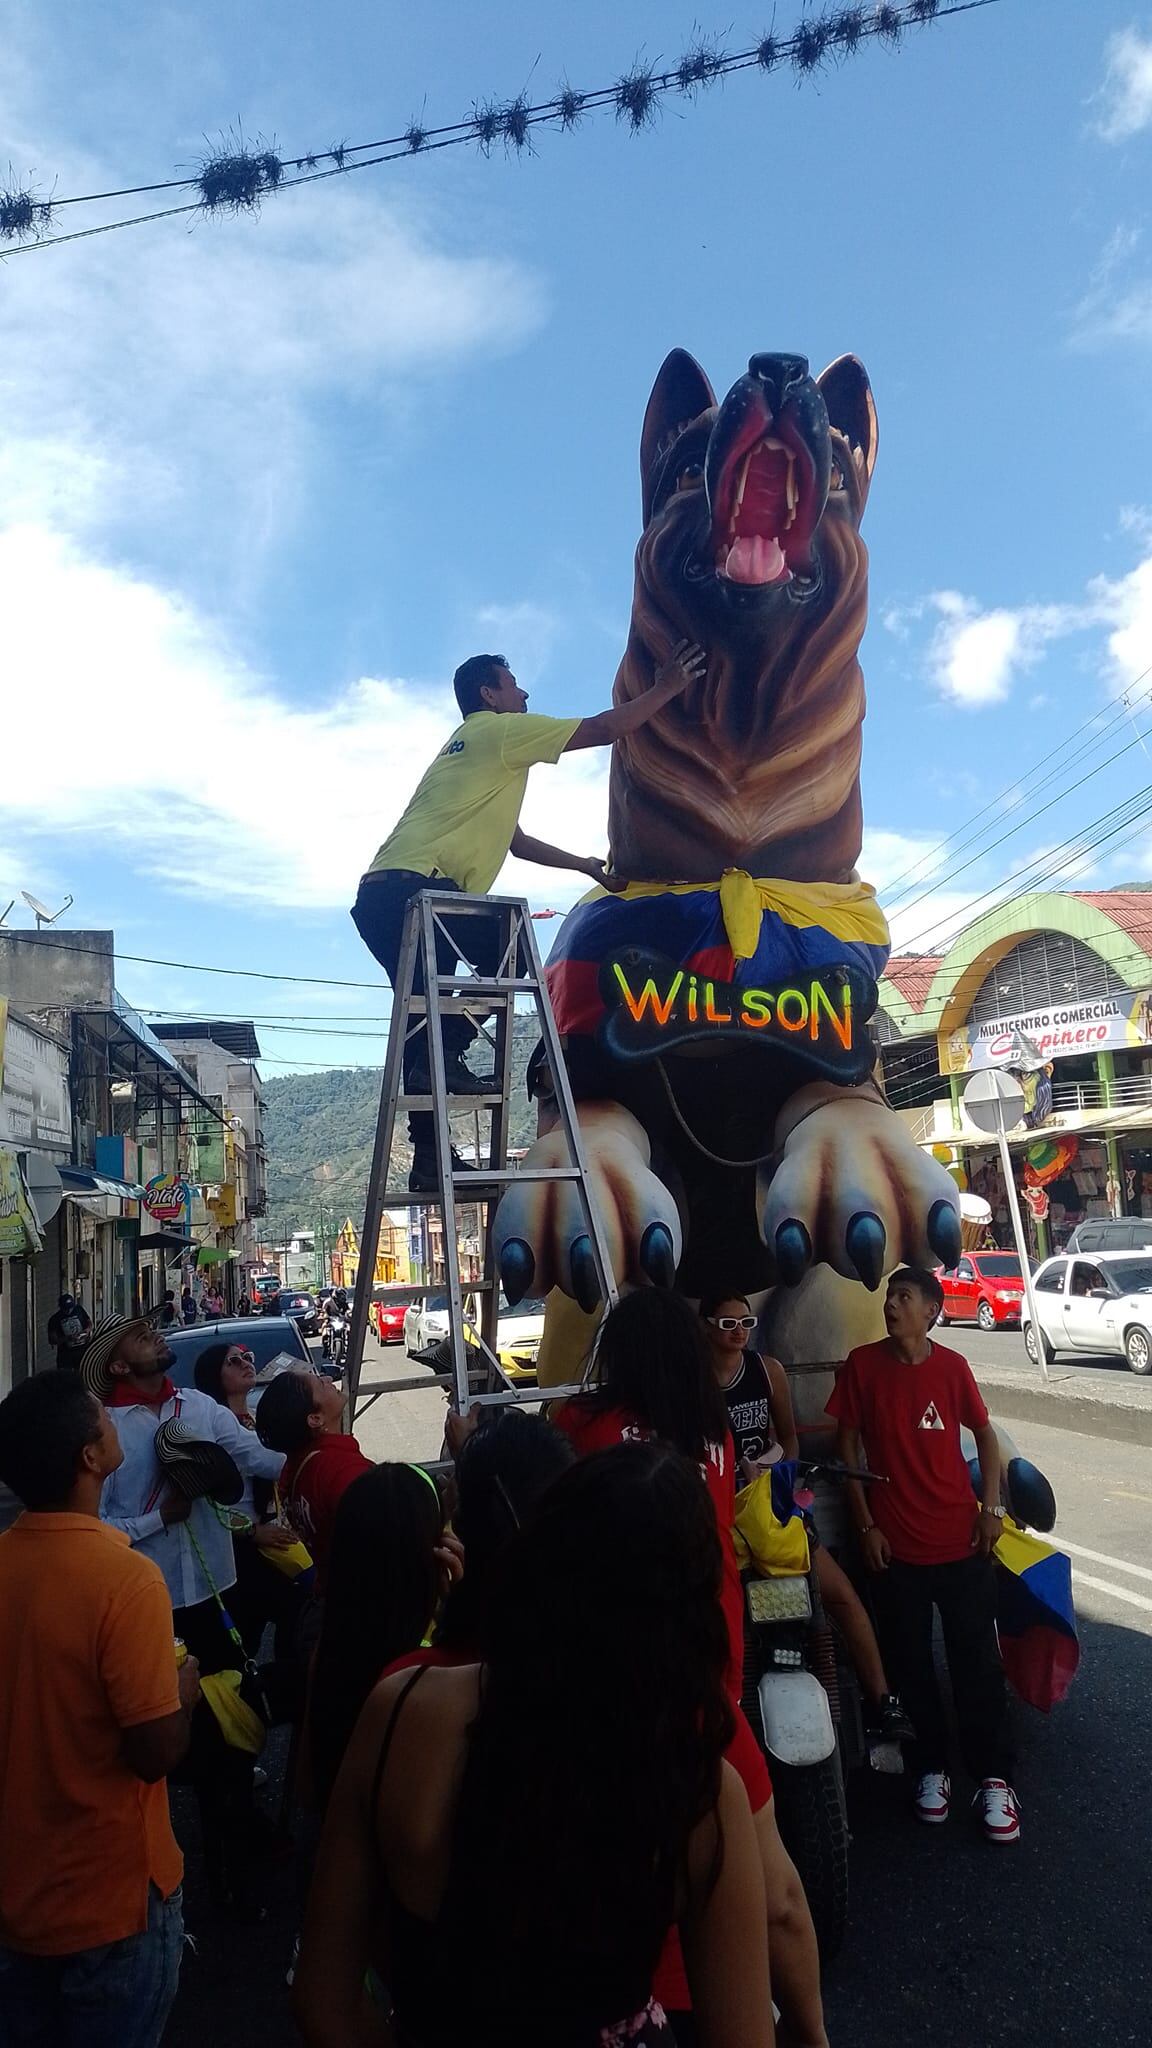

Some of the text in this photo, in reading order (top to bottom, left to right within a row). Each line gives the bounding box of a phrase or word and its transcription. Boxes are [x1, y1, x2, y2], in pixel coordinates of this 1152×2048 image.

[980, 1002, 1120, 1038] MULTICENTRO COMERCIAL
[990, 1025, 1107, 1055] Cpinero
